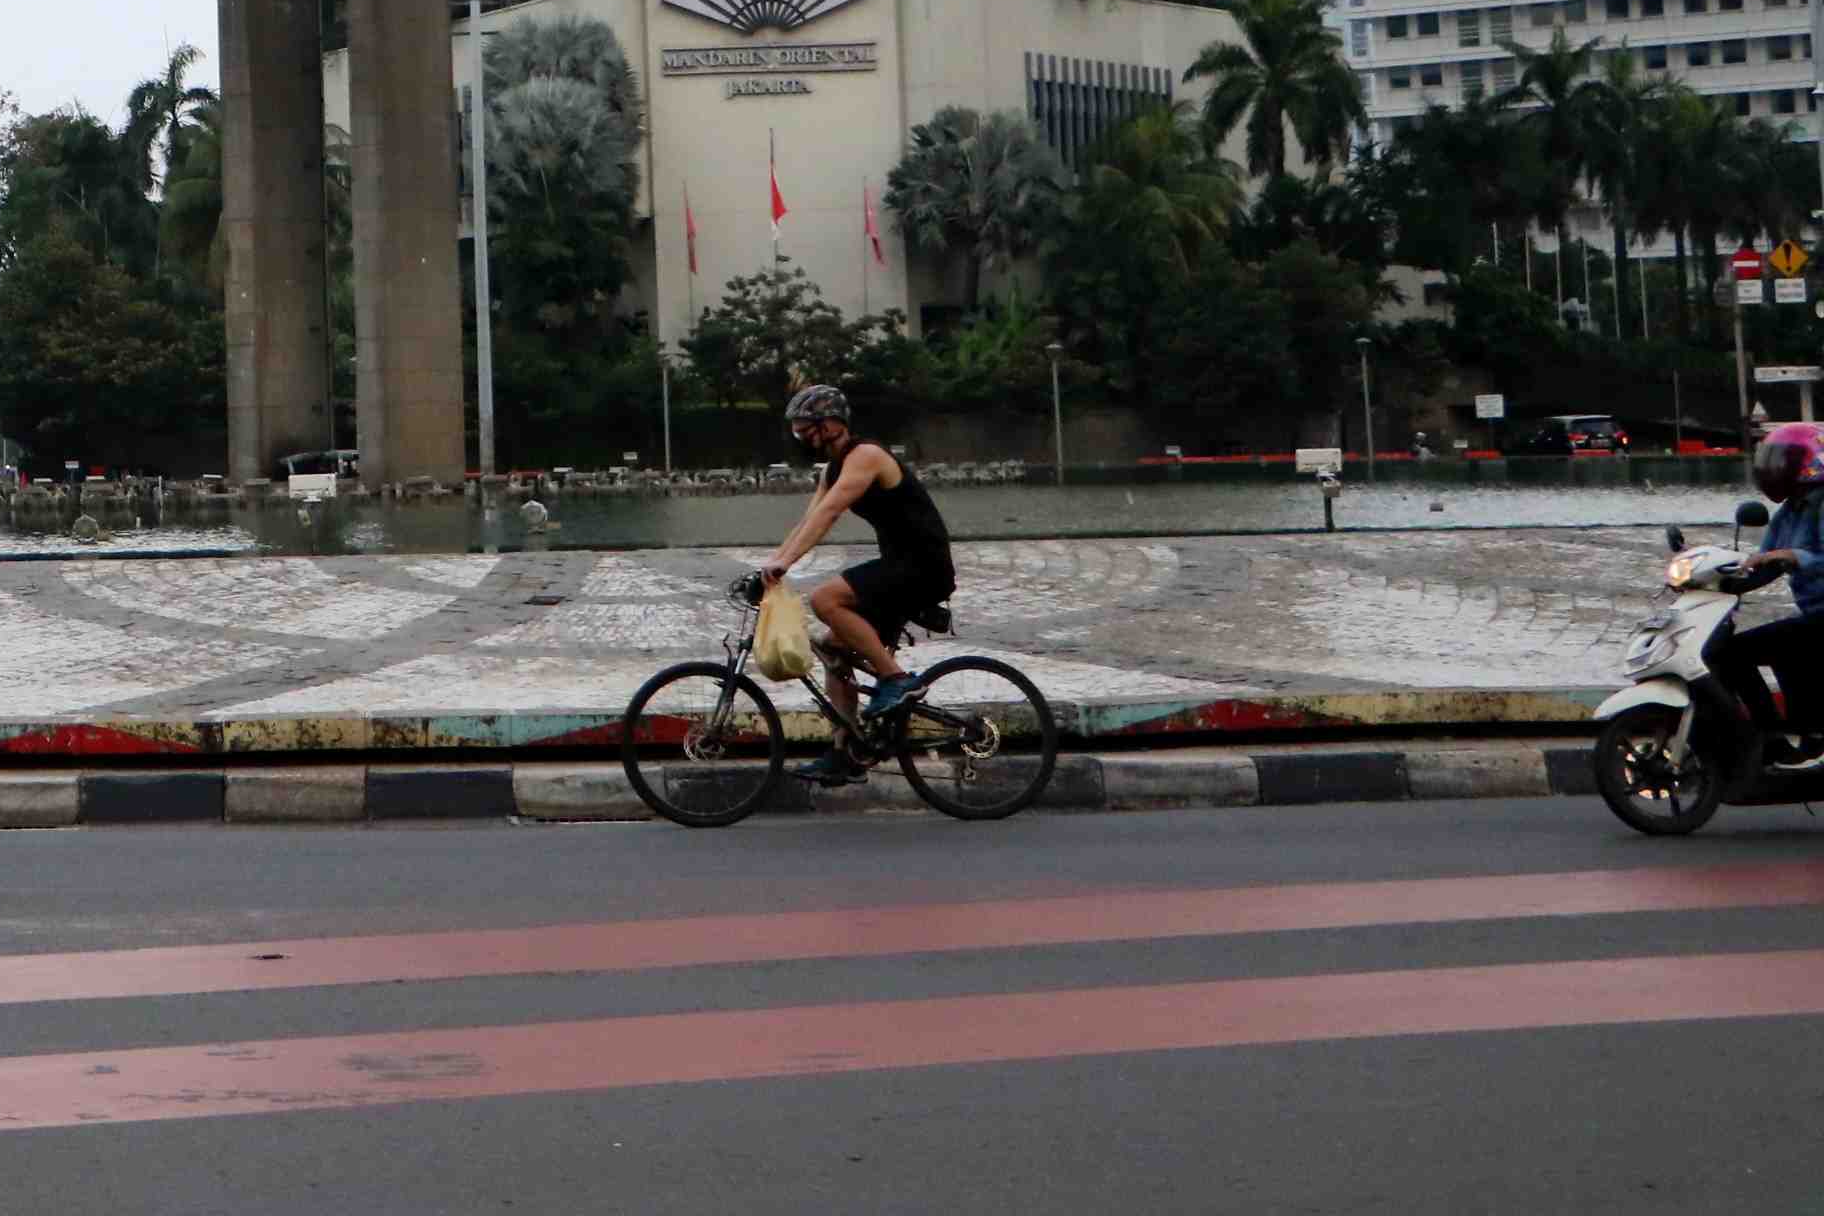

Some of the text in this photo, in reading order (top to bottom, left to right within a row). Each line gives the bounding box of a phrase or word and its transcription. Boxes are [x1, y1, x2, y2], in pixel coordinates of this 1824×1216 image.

[664, 47, 876, 68] MANDARIN ORIENTAL
[725, 79, 811, 98] JAKARTA
